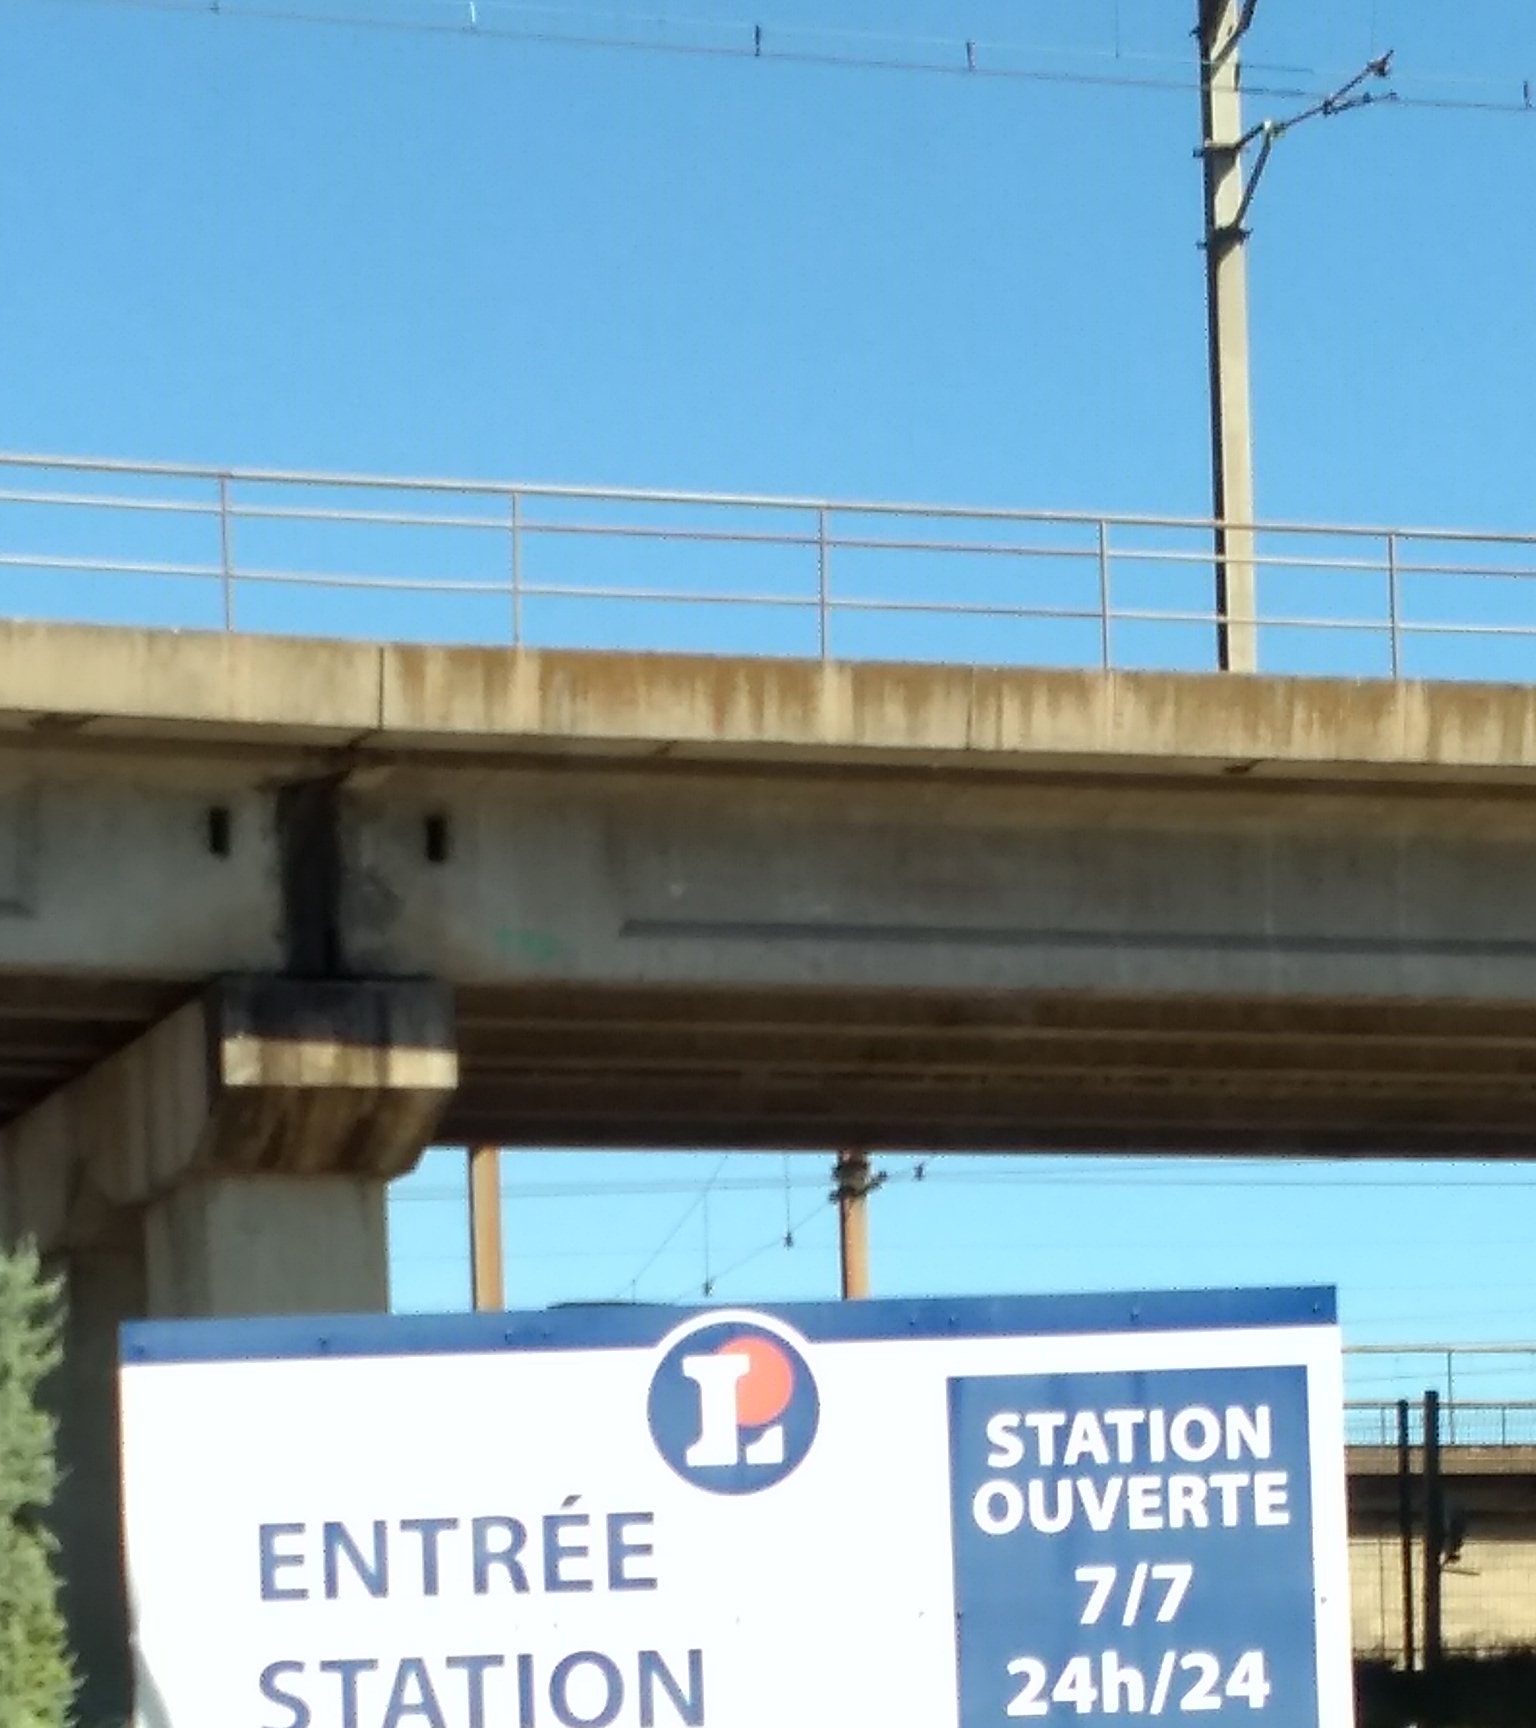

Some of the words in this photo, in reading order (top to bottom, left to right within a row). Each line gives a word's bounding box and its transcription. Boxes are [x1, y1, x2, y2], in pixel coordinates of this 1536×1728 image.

[985, 1405, 1272, 1469] STATION
[972, 1470, 1291, 1535] OUVERTE
[259, 1495, 658, 1601] ENTRÉE
[1075, 1562, 1193, 1627] 7/7
[1006, 1650, 1271, 1717] 24h/24
